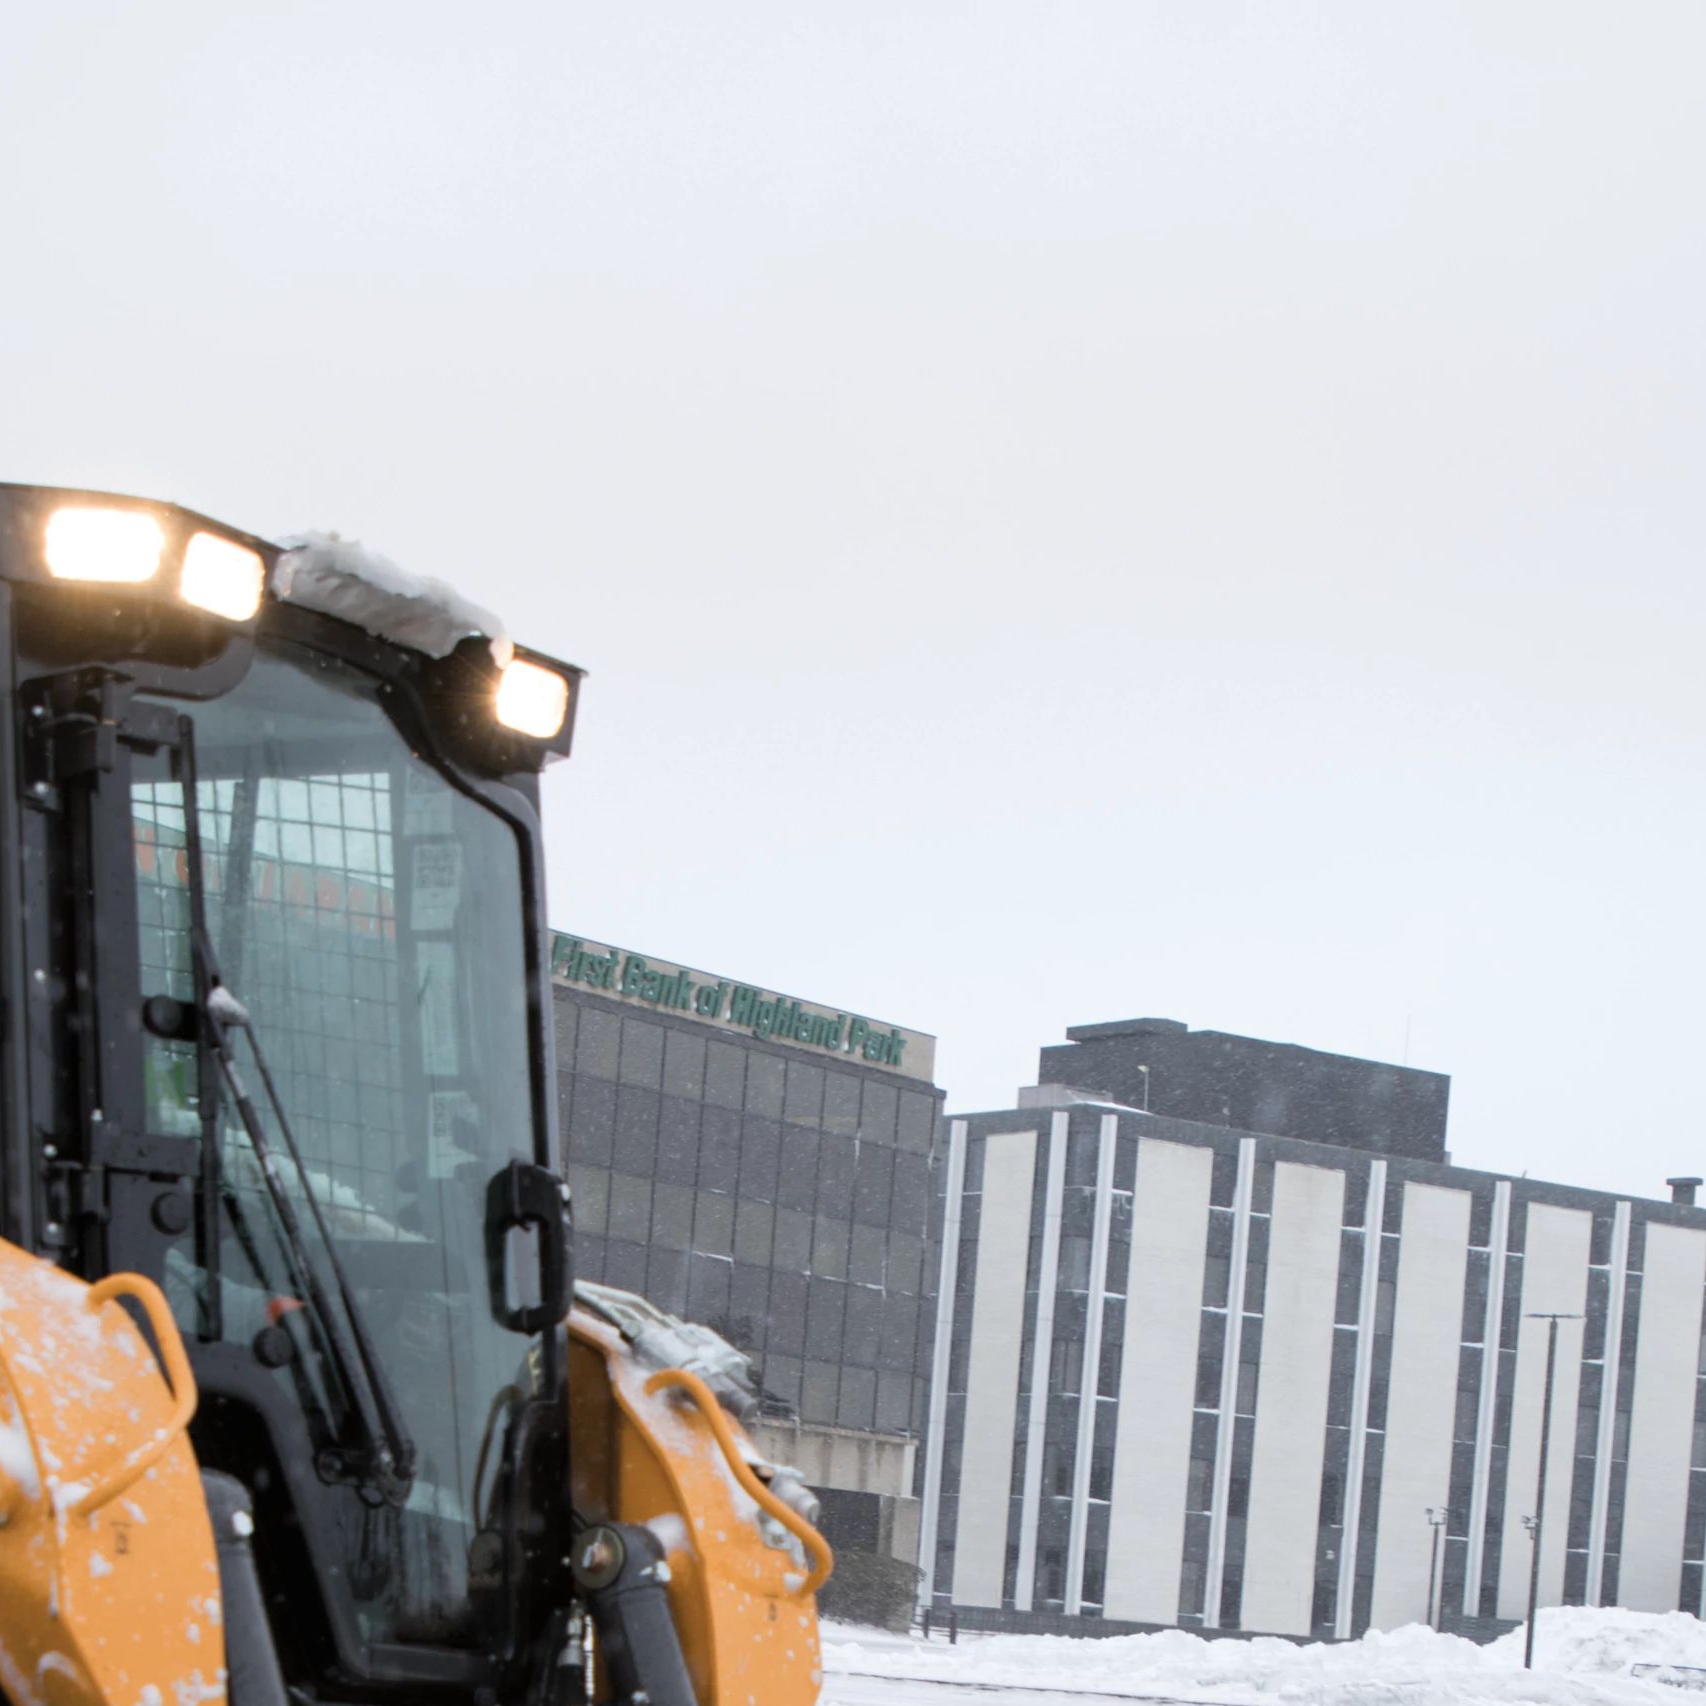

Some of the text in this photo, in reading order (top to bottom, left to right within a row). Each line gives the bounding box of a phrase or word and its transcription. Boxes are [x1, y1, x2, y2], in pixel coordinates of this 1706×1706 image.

[551, 935, 908, 1067] First Bank of Highland Park
